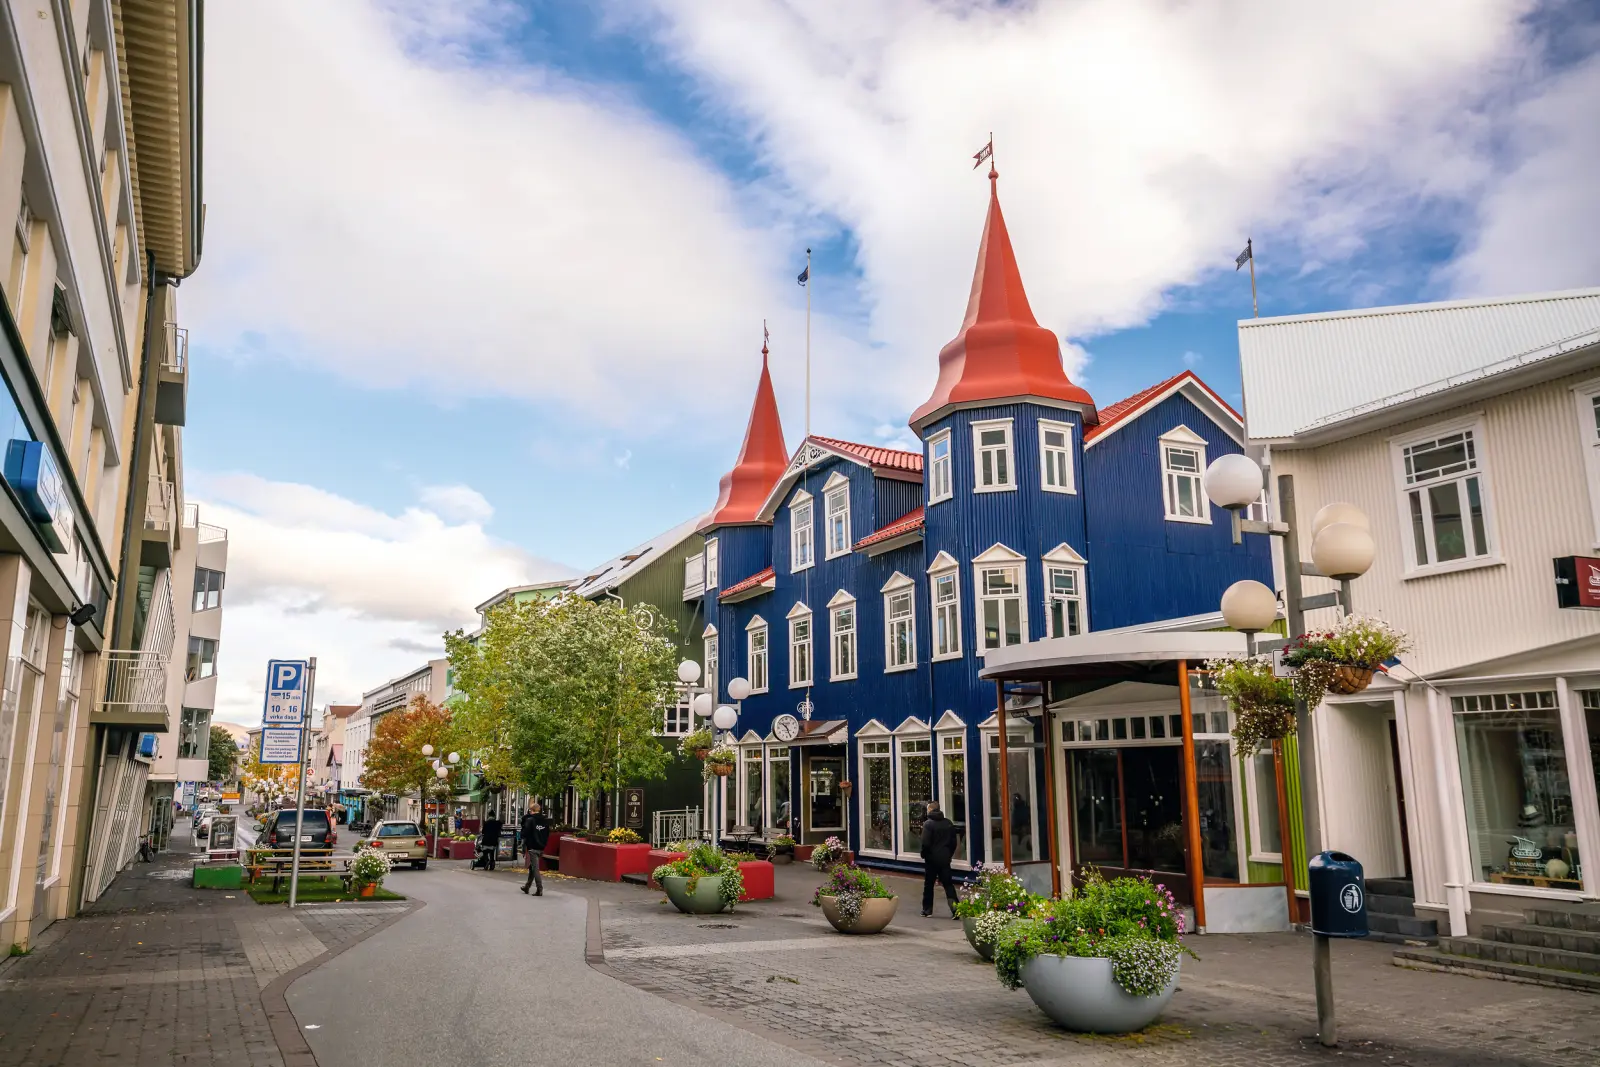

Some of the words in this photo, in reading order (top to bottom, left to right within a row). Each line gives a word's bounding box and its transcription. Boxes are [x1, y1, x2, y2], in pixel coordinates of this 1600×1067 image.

[277, 666, 296, 689] P
[282, 692, 290, 700] 15
[271, 705, 281, 713] 10
[289, 705, 298, 713] 16
